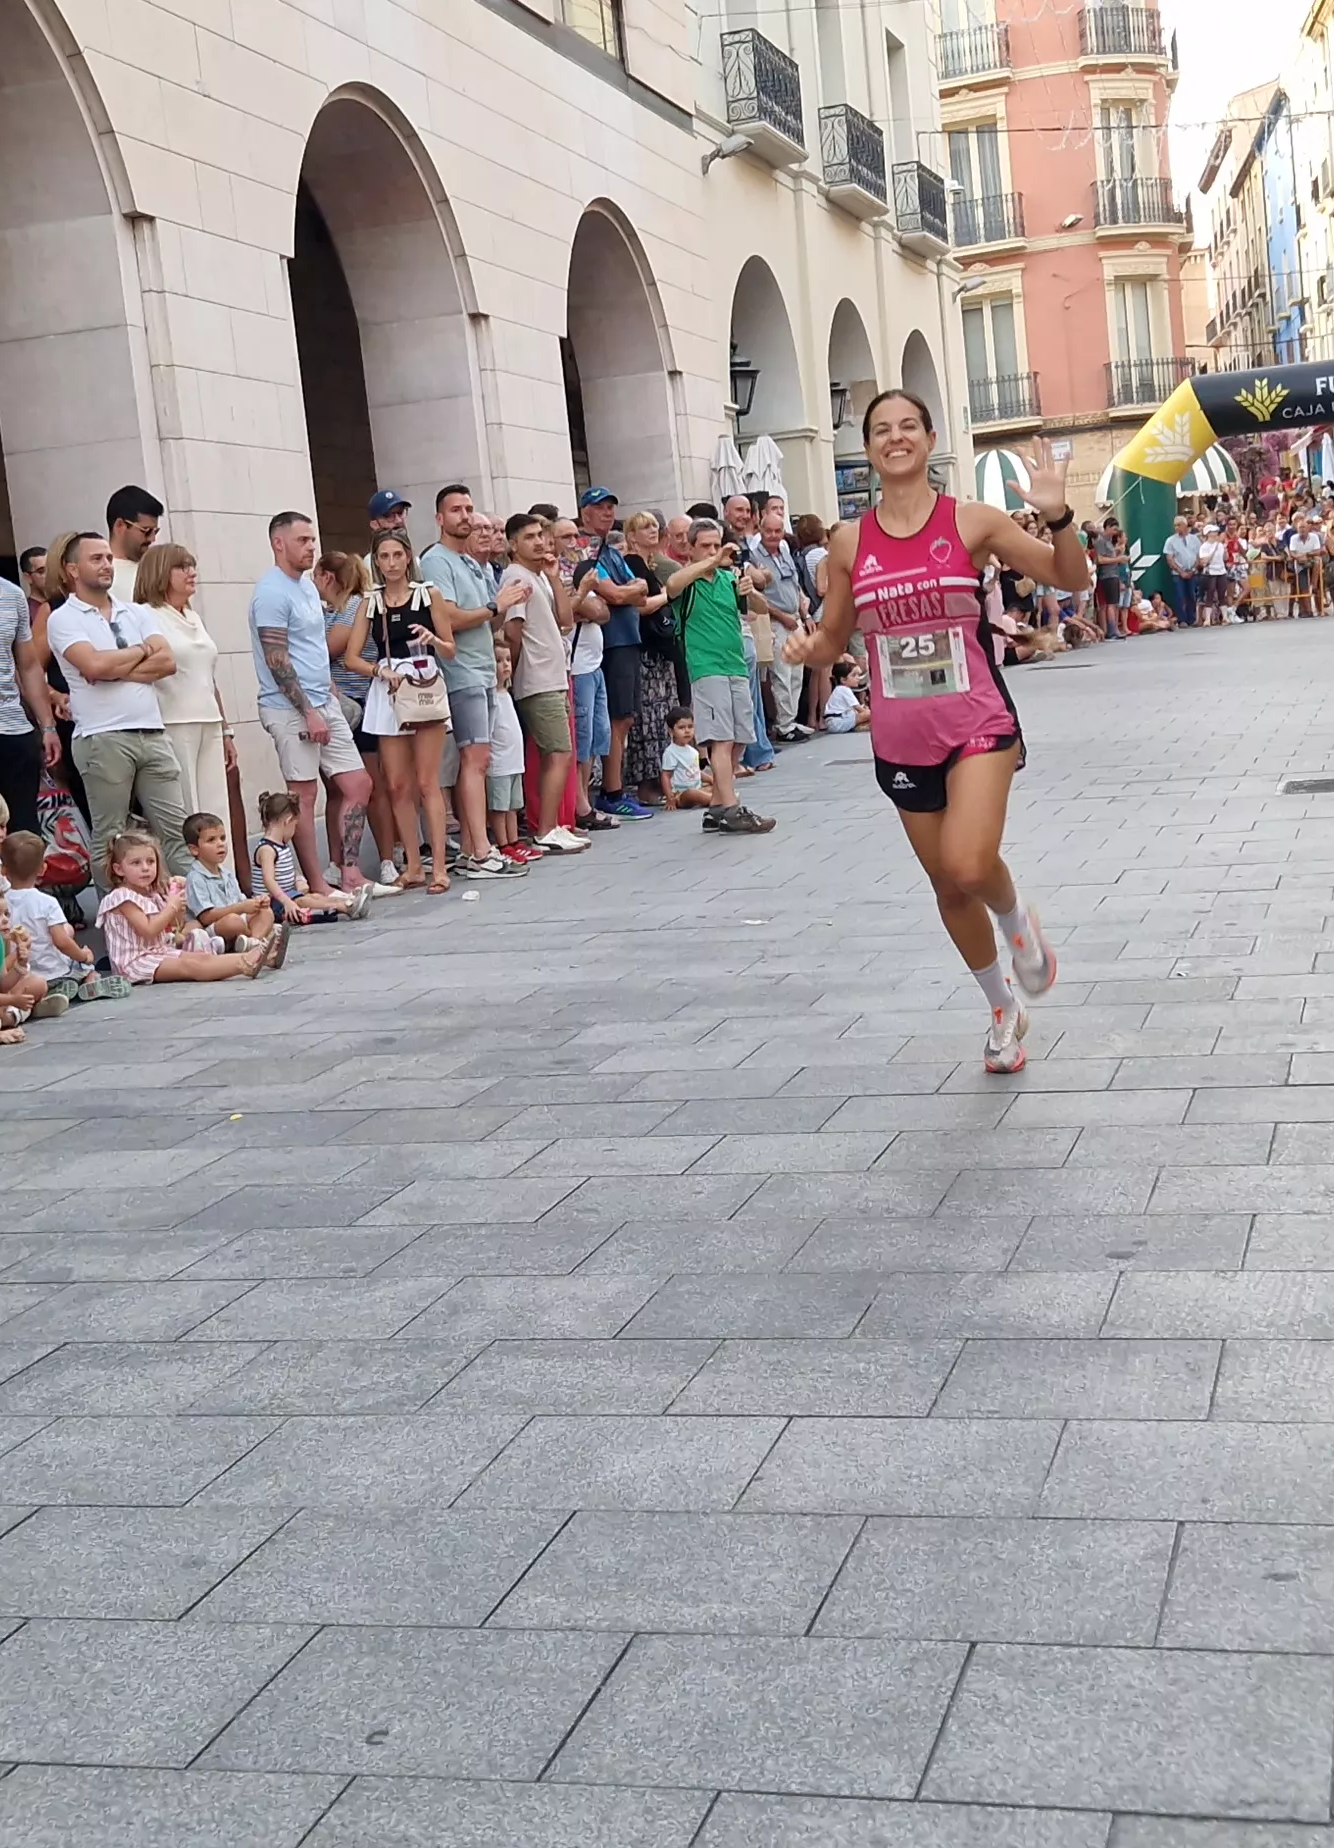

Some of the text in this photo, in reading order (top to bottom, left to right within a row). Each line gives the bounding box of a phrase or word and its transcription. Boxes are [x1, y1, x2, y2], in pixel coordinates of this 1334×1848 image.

[1282, 402, 1326, 419] CAJA
[877, 578, 938, 602] Nata con
[878, 591, 942, 627] FRESAS
[900, 633, 935, 658] 25
